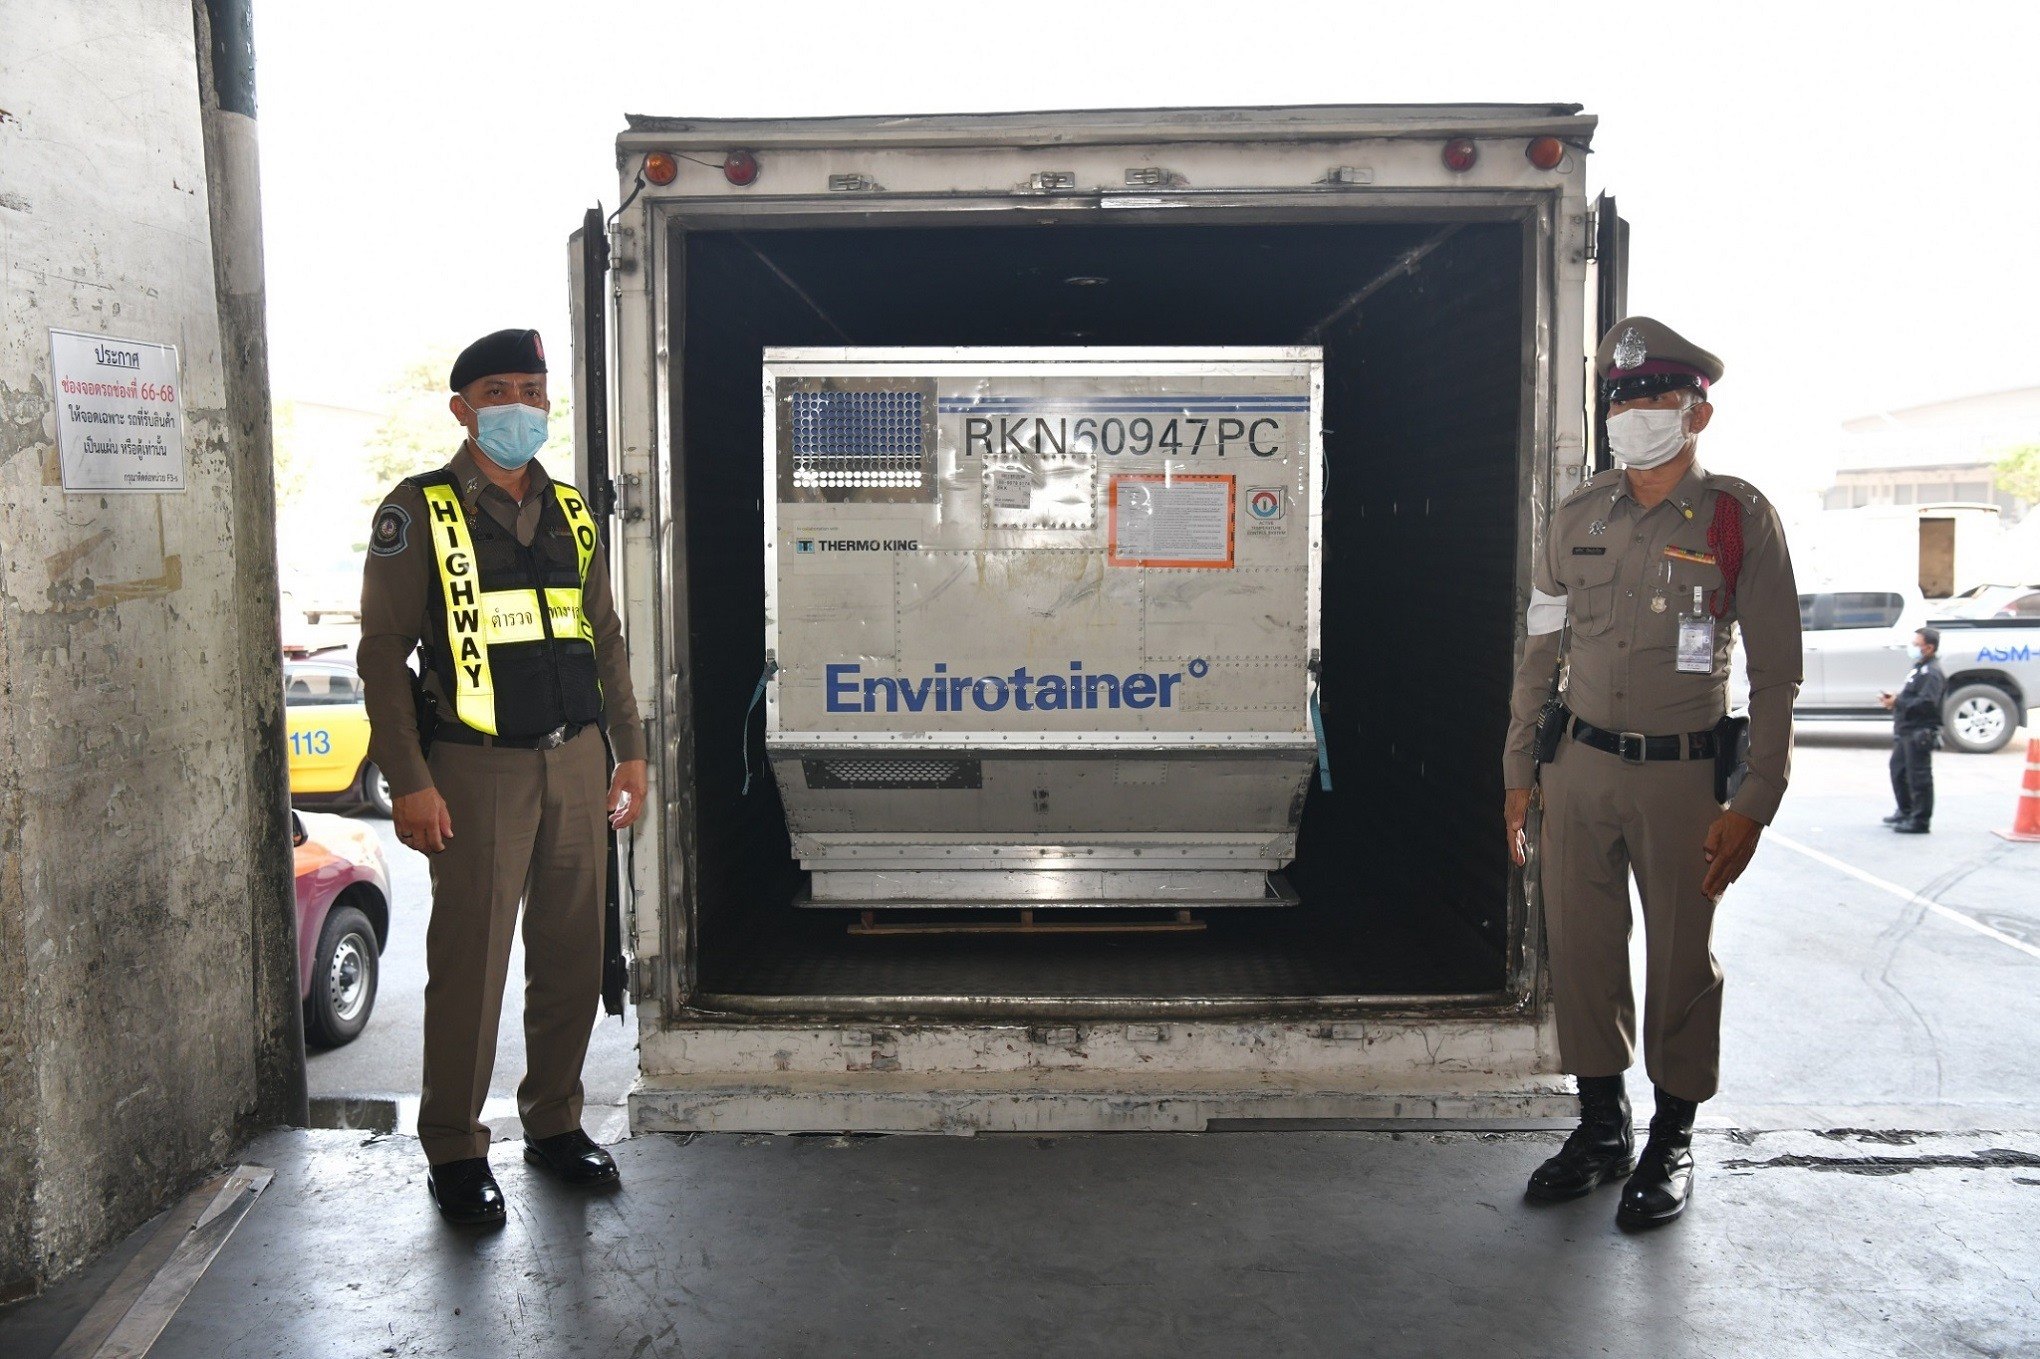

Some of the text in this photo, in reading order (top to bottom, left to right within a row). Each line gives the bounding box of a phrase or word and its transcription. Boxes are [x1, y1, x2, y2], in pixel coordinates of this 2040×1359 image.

[95, 344, 140, 368] ประกาศ
[141, 382, 175, 402] 66-68
[965, 417, 1279, 457] RKN60947PC
[818, 540, 918, 552] THERMO KING
[431, 500, 482, 688] HIGHWAY
[491, 606, 533, 628] ตำรวจ
[289, 730, 331, 756] 113
